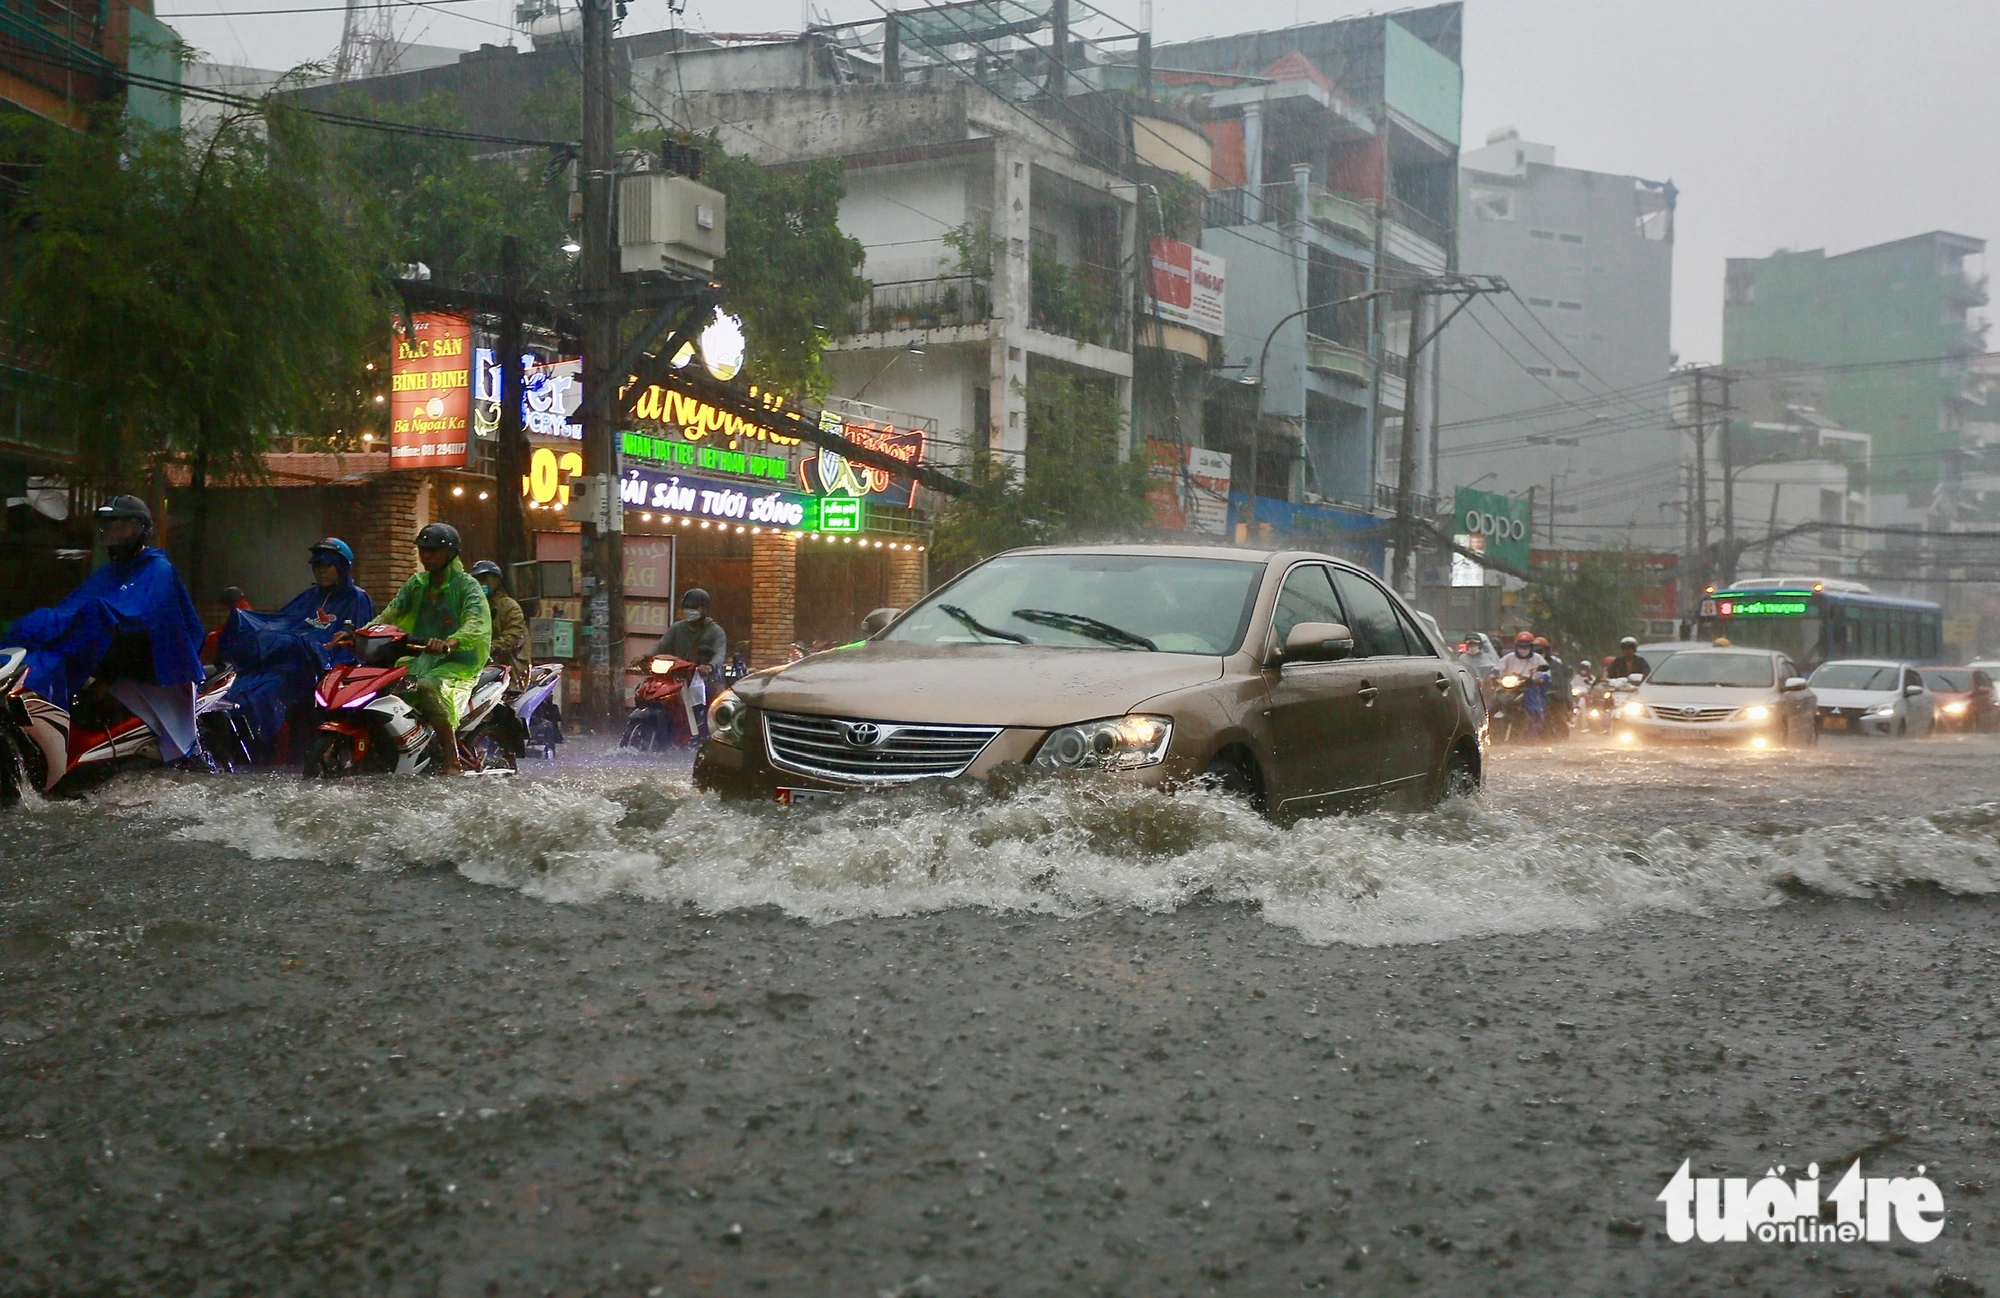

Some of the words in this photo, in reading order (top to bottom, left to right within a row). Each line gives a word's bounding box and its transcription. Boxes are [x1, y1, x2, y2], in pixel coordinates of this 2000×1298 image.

[433, 333, 462, 357] SẢN
[392, 369, 428, 391] BÌNH
[430, 370, 468, 393] ĐỊNH
[394, 418, 410, 433] Bà
[411, 418, 447, 435] Ngoại
[448, 417, 466, 430] Ka
[651, 476, 696, 511] SẢN
[700, 488, 748, 519] TƯƠI
[749, 492, 804, 526] SỐNG
